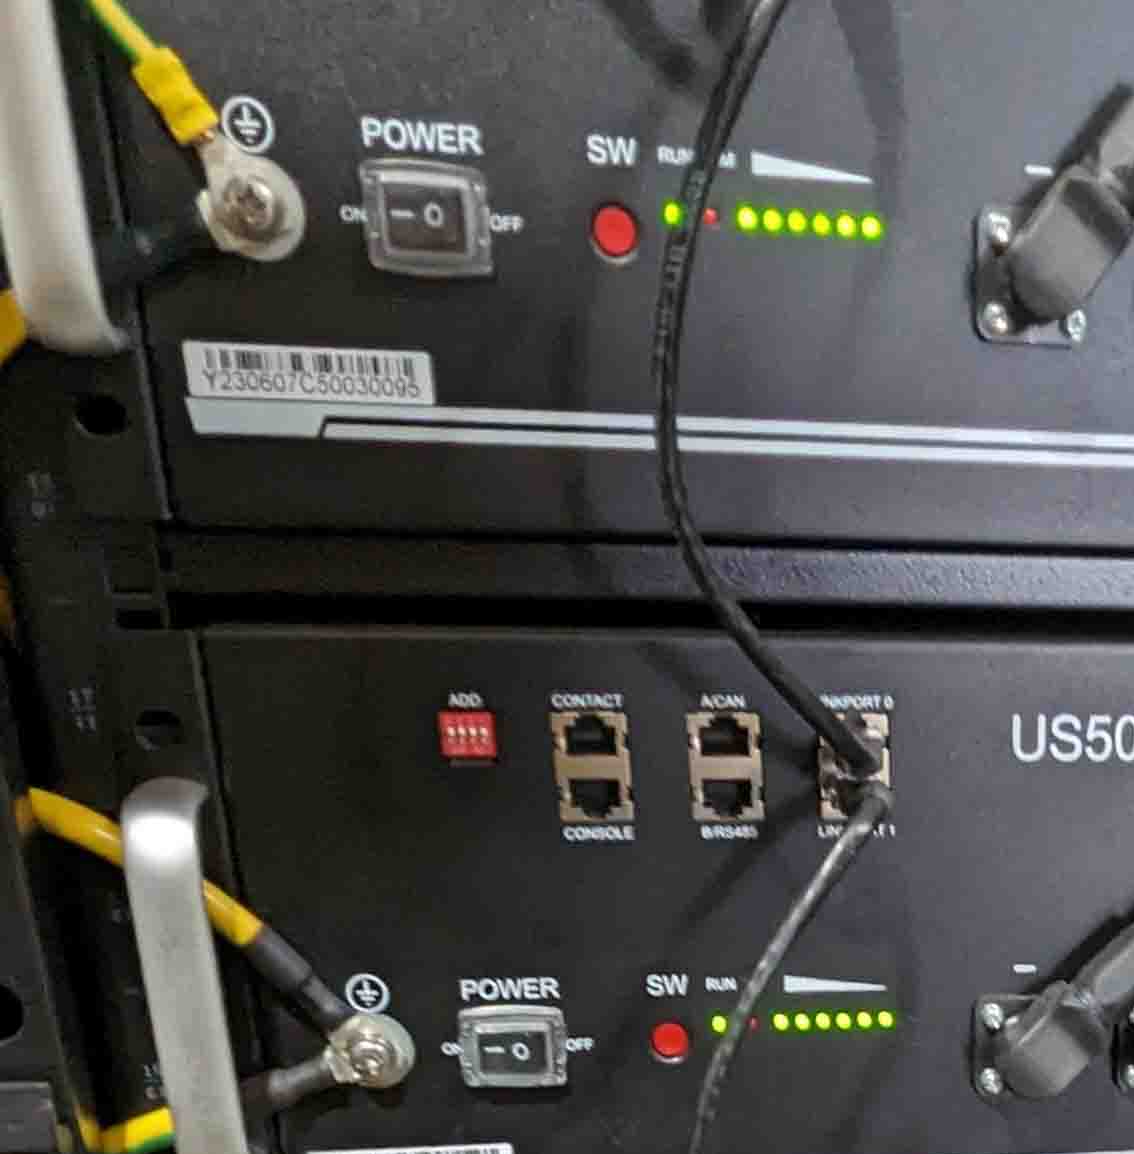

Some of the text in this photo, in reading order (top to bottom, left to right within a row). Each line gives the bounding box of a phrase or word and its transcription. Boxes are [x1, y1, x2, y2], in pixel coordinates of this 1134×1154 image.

[361, 115, 485, 156] POWER
[586, 133, 637, 167] SW
[657, 145, 694, 166] RUN
[489, 212, 525, 233] OFF
[201, 367, 422, 398] Y230607C50030095
[449, 692, 484, 708] ADD
[551, 692, 624, 709] CONTACT
[563, 824, 635, 842] CONSOLE
[459, 976, 561, 1001] POWER
[646, 972, 689, 998] SW
[704, 976, 737, 993] RUN
[565, 1036, 594, 1052] OFF
